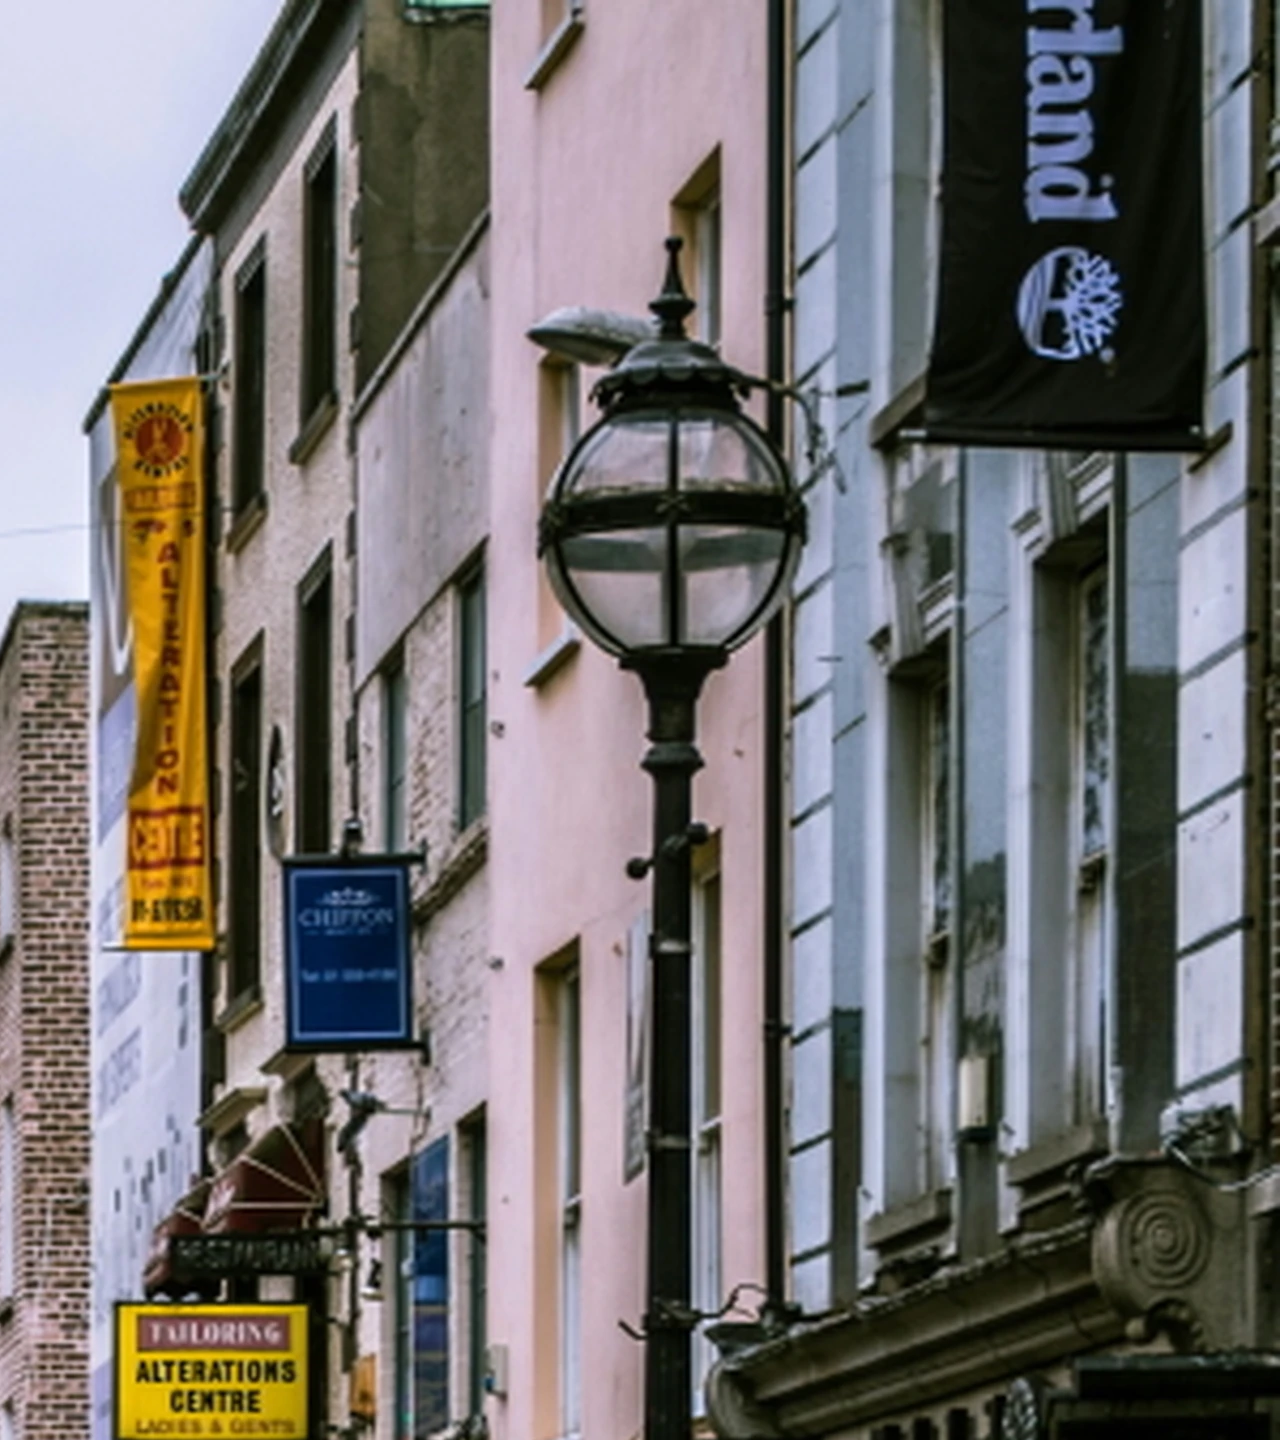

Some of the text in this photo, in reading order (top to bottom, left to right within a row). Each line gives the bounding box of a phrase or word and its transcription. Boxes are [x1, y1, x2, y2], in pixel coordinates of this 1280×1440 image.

[149, 1320, 282, 1345] TAILORING
[135, 1359, 297, 1383] ALTERATIONS
[169, 1389, 261, 1413] CENTRE
[136, 1419, 202, 1434] LADIES
[230, 1419, 295, 1434] GENTS
